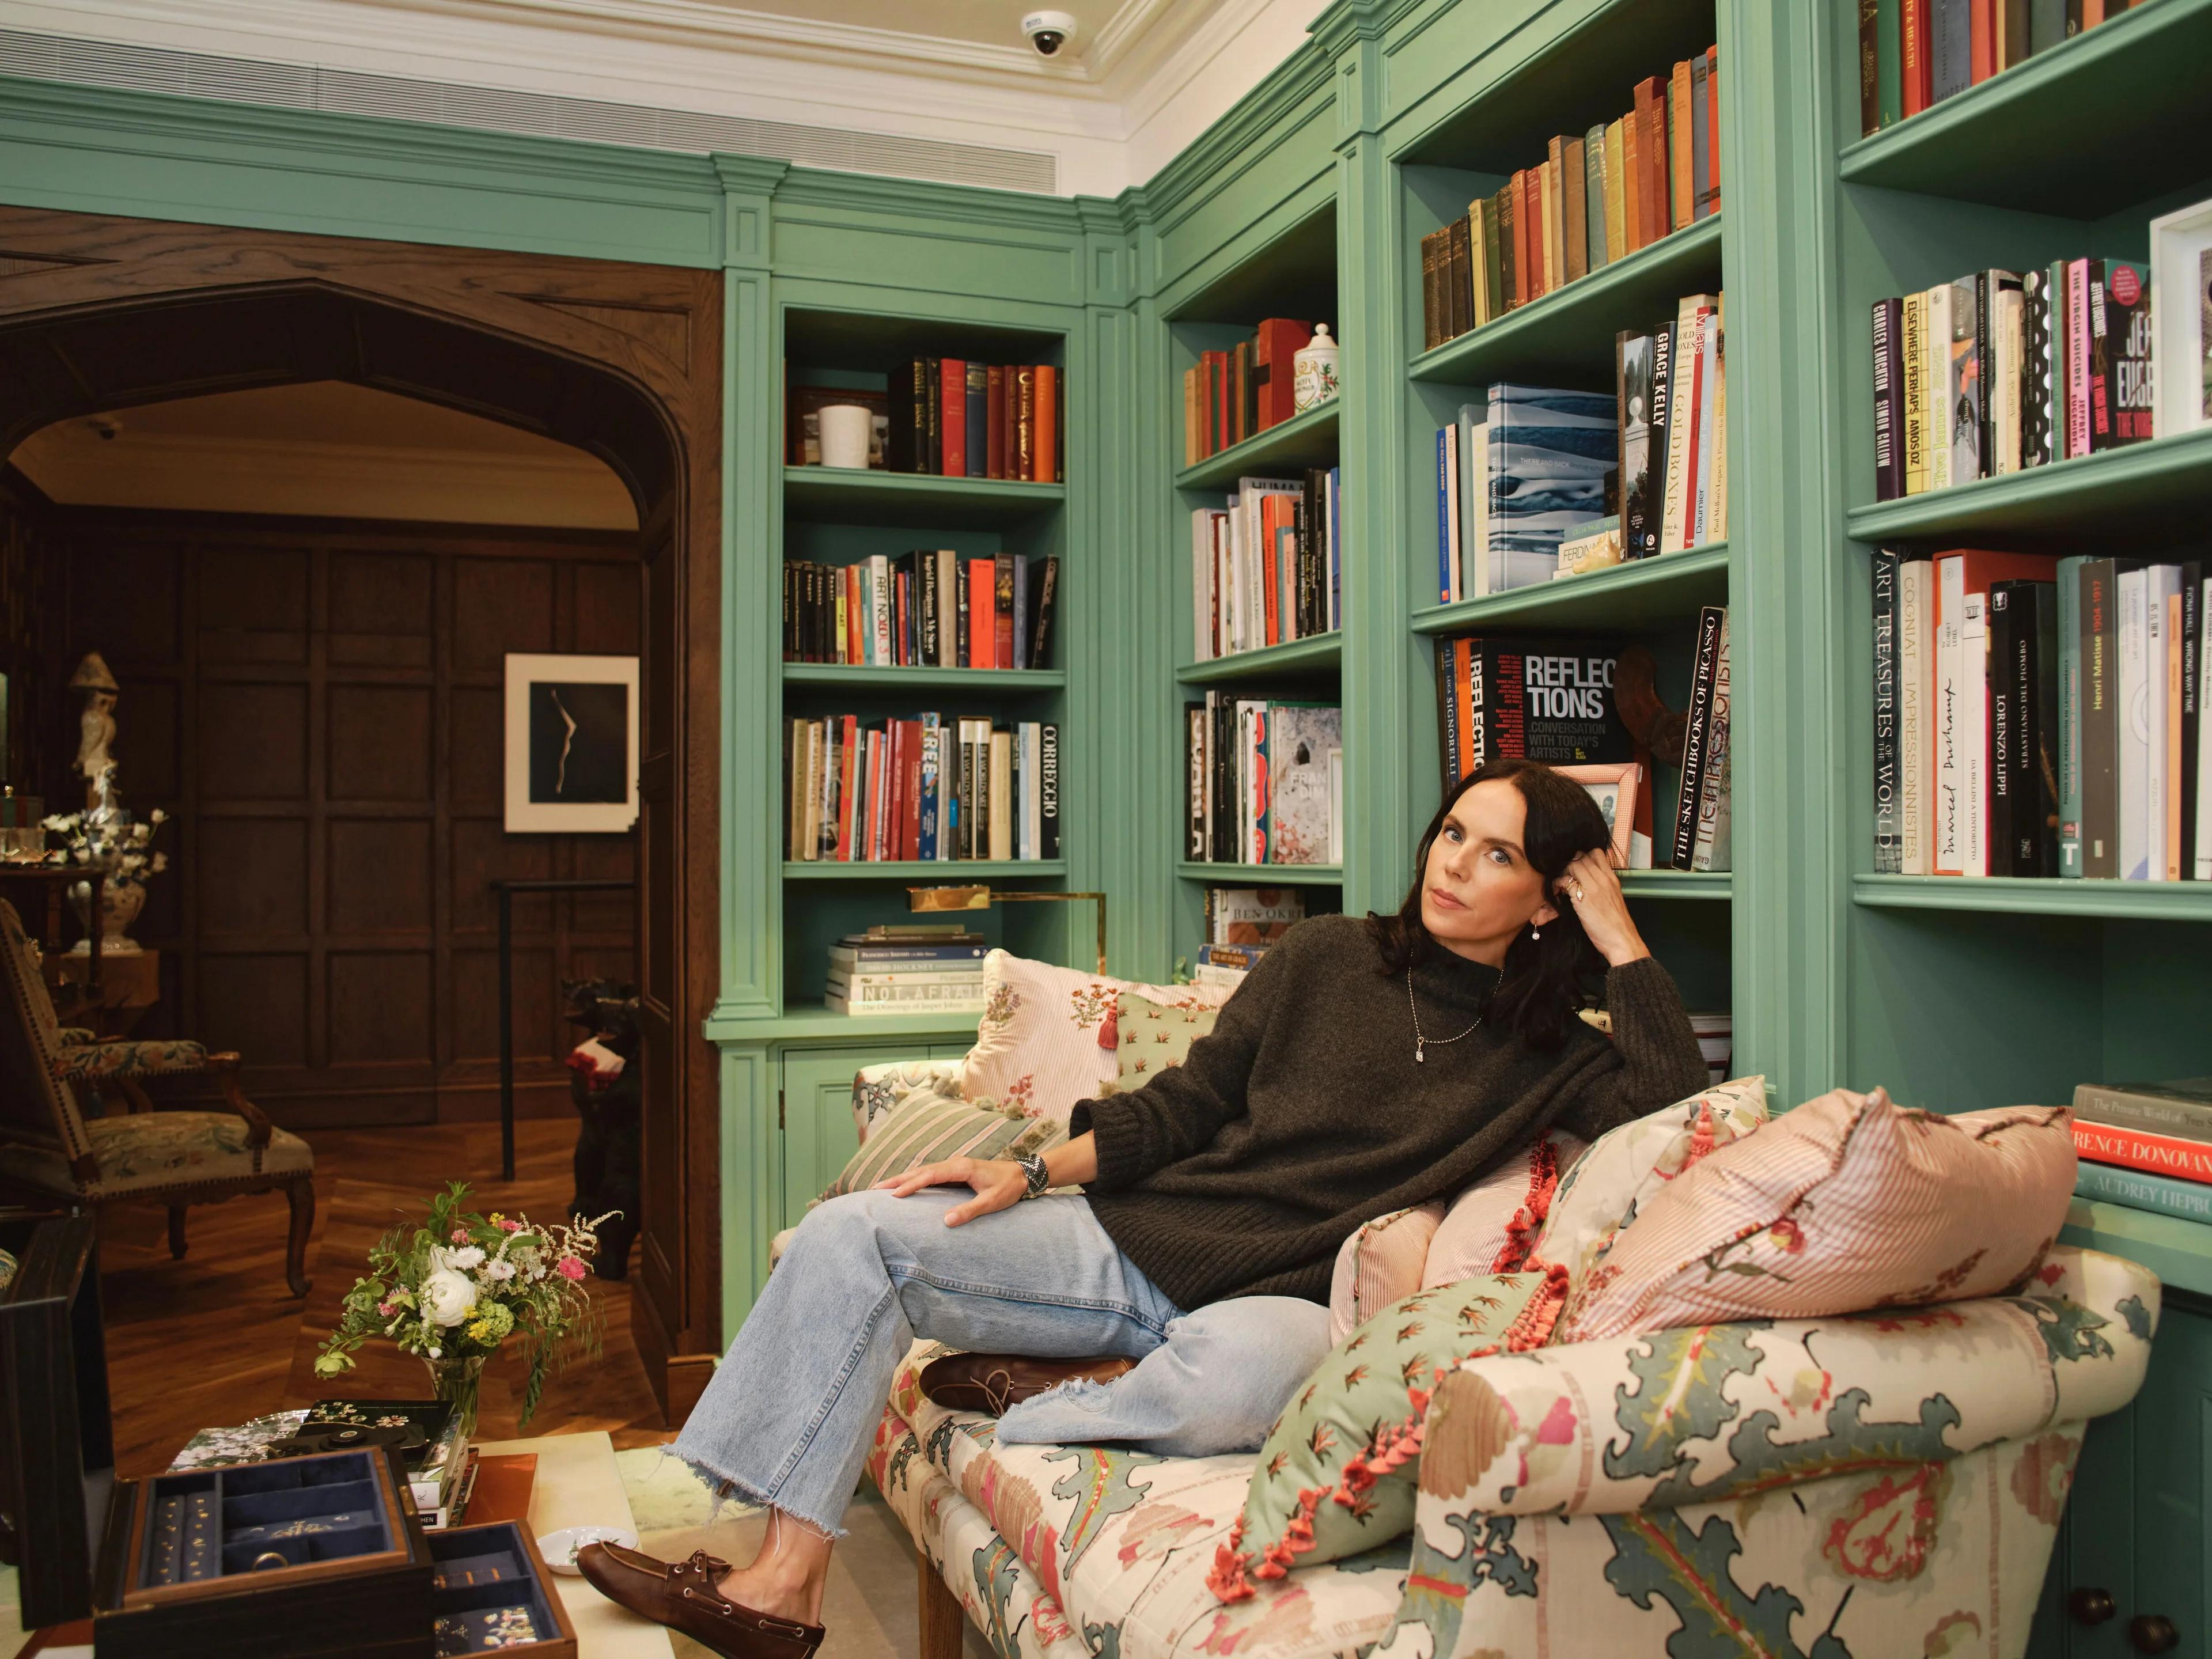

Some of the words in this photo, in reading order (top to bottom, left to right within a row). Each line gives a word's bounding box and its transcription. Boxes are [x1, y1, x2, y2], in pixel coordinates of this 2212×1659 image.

[1906, 26, 1914, 69] HEALTH
[2090, 281, 2104, 305] JEFFREY
[1695, 313, 1709, 355] Millais
[1873, 304, 1887, 346] CHARLES
[1907, 301, 1918, 365] ELSEWHERE
[2092, 305, 2107, 339] EUGENIDES
[1655, 332, 1669, 380] GRACE
[1874, 346, 1888, 392] LAUGHTON
[2074, 338, 2082, 388] SUICIDES
[1908, 366, 1919, 415] PERHAPS
[2093, 374, 2105, 386] THE
[2093, 387, 2106, 407] VIRGIN
[1653, 385, 1666, 426] KELLY
[1875, 400, 1889, 430] SIMON
[2094, 407, 2108, 434] SUICIDES
[1671, 395, 1684, 452] GOLD
[1700, 433, 1707, 444] of
[1909, 419, 1919, 450] AMOS
[1933, 396, 1948, 450] James
[1520, 457, 1541, 466] THERE
[1699, 448, 1707, 486] Visions
[1877, 433, 1890, 468] CALLOW
[1910, 451, 1919, 466] OZ
[1666, 454, 1680, 517] BOXES
[1715, 466, 1724, 487] Legacy
[1696, 489, 1704, 534] Daumier
[924, 555, 934, 580] Ingrid
[1876, 559, 1892, 603] ART
[877, 576, 888, 602] ART
[925, 581, 935, 618] Bergman
[2185, 586, 2194, 612] FIONA
[877, 603, 888, 637] NOW
[1904, 577, 1916, 658] COGNIAT
[2092, 580, 2102, 633] 1904-1917
[926, 619, 936, 632] My
[2185, 613, 2194, 635] HALL
[880, 646, 890, 654] 3
[926, 632, 936, 655] Story
[1699, 616, 1715, 680] PICASSO
[2092, 635, 2102, 676] Matisse
[2185, 640, 2194, 672] WRONG
[1526, 655, 1617, 689] REFLEC
[1876, 608, 1892, 737] TREASURES
[2185, 674, 2193, 692] WAY
[1527, 687, 1604, 719] TIONS
[1696, 682, 1706, 704] OF
[2092, 680, 2102, 710] Henri
[2184, 694, 2193, 713] TIME
[813, 727, 821, 745] ART
[1446, 697, 1456, 775] SIGNORELLI
[1529, 734, 1555, 747] WITH
[1557, 735, 1599, 747] TODAY'S
[1997, 694, 2006, 760] LORENZO
[922, 724, 938, 774] TREE
[1530, 747, 1571, 759] ARTISTS
[1681, 707, 1703, 824] SKETCHBOOKS
[1885, 744, 1892, 757] OF
[1971, 759, 1977, 770] DA
[1042, 725, 1058, 818] CORREGGIO
[1905, 681, 1917, 859] IMPRESSIONNISTES
[1997, 763, 2007, 796] LIPPI
[1877, 765, 1892, 849] WORLD
[1942, 785, 1956, 854] Marcel
[1676, 827, 1689, 860] THE
[1233, 908, 1261, 920] BEN
[1266, 908, 1302, 920] OKRI
[2093, 1097, 2109, 1111] The
[2111, 1100, 2141, 1116] Private
[2143, 1106, 2170, 1120] World
[2171, 1110, 2181, 1123] of
[2184, 1113, 2205, 1126] Yves
[2072, 1130, 2128, 1157] RENCE
[2132, 1142, 2212, 1174] DONOVAN
[2095, 1176, 2160, 1202] AUDREY
